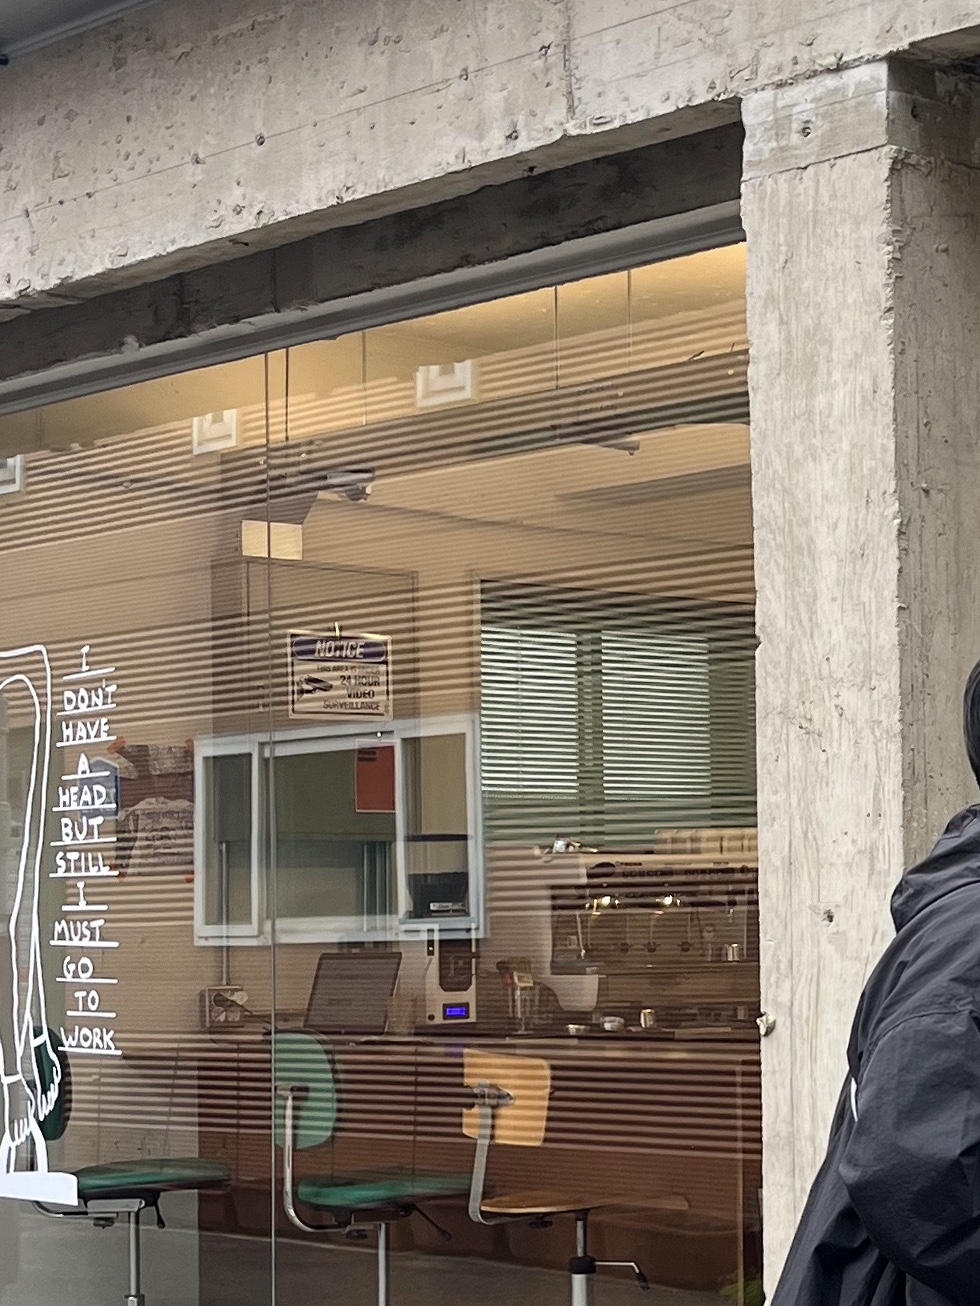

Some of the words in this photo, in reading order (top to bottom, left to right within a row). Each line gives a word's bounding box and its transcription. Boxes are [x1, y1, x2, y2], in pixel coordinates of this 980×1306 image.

[80, 644, 91, 672] I
[340, 674, 352, 686] 24
[63, 678, 117, 711] DON'T
[346, 687, 375, 699] VIDEO
[323, 701, 381, 711] SURVEILLANCE
[62, 717, 110, 742] HAVE
[77, 752, 91, 775] A
[58, 783, 107, 808] HEAD
[60, 815, 105, 842] BUT
[55, 850, 111, 875] STILL
[76, 880, 88, 906] I
[53, 918, 106, 942] MUST
[63, 955, 94, 979] GO
[74, 989, 100, 1011] TO
[60, 1024, 116, 1050] WORK
